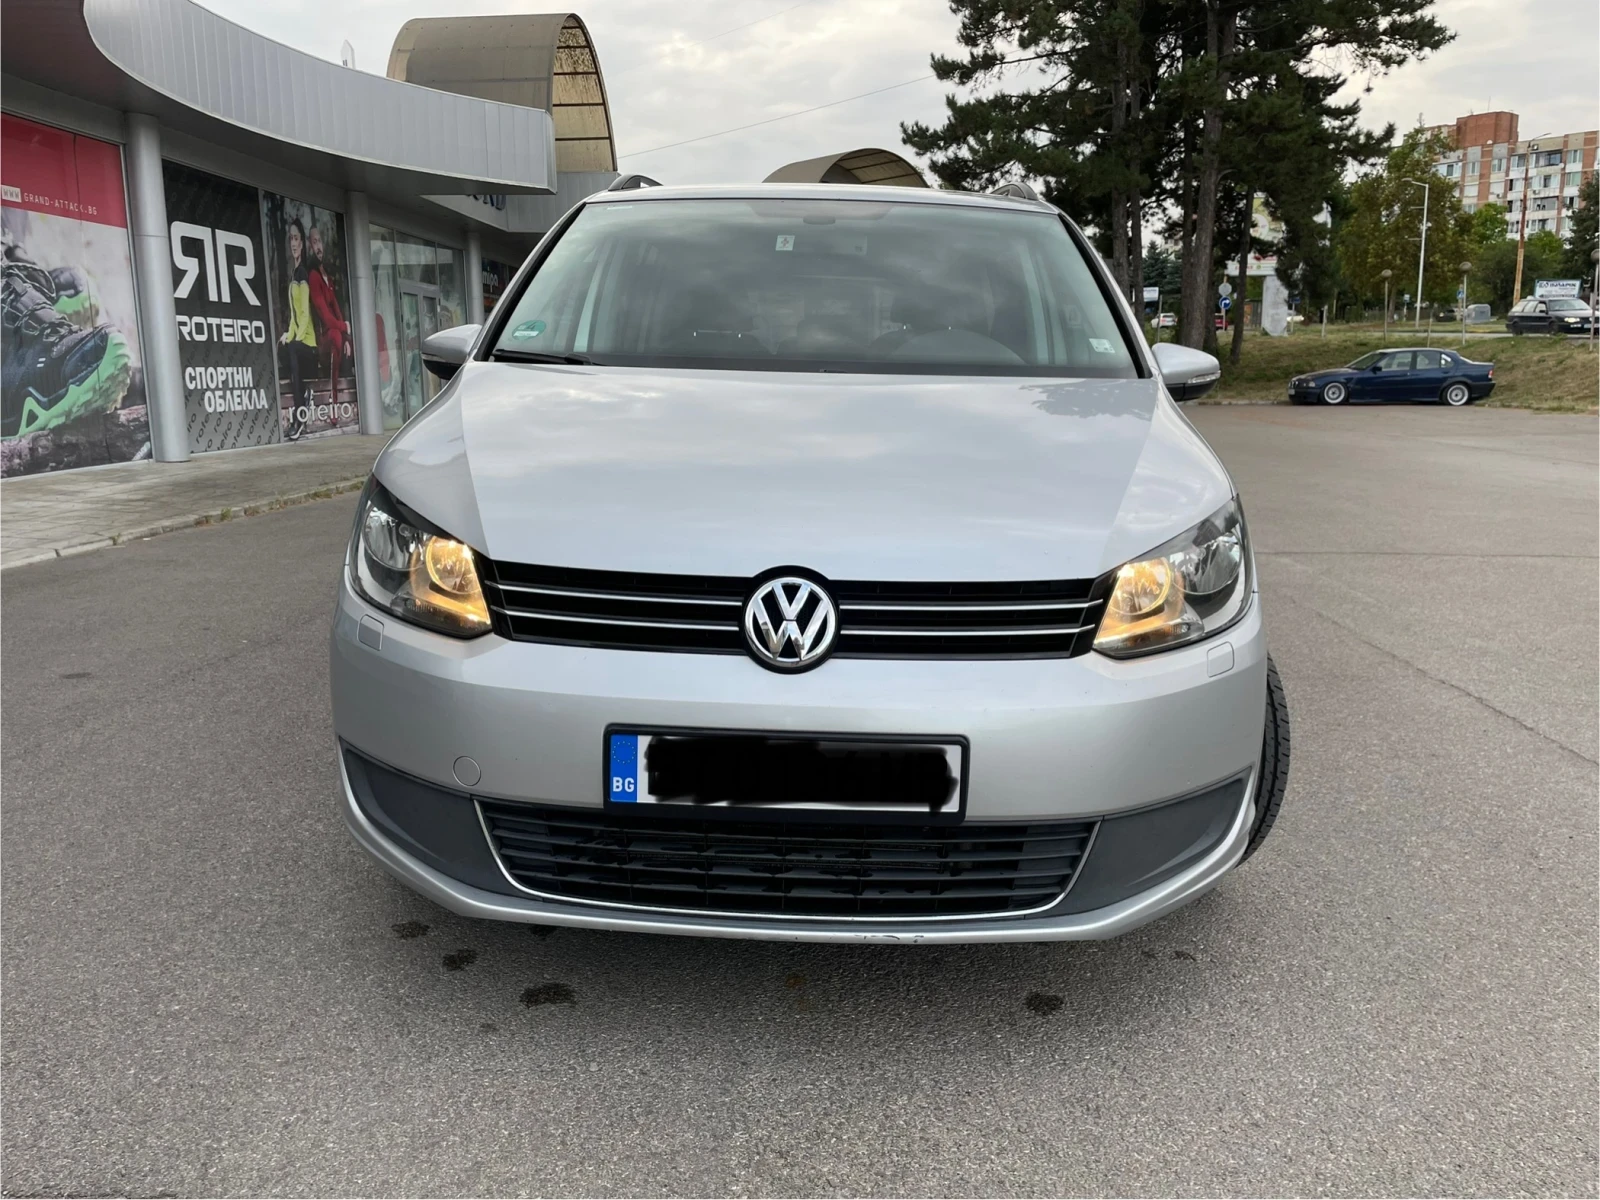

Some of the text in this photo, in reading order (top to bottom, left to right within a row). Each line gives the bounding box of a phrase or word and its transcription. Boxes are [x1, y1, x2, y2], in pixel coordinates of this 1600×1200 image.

[175, 315, 266, 344] ROTEIRO
[184, 366, 253, 390] СПОРТНИ
[204, 388, 269, 413] ОБЛЕКЛА
[288, 398, 352, 423] roteiro
[612, 777, 635, 793] BG
